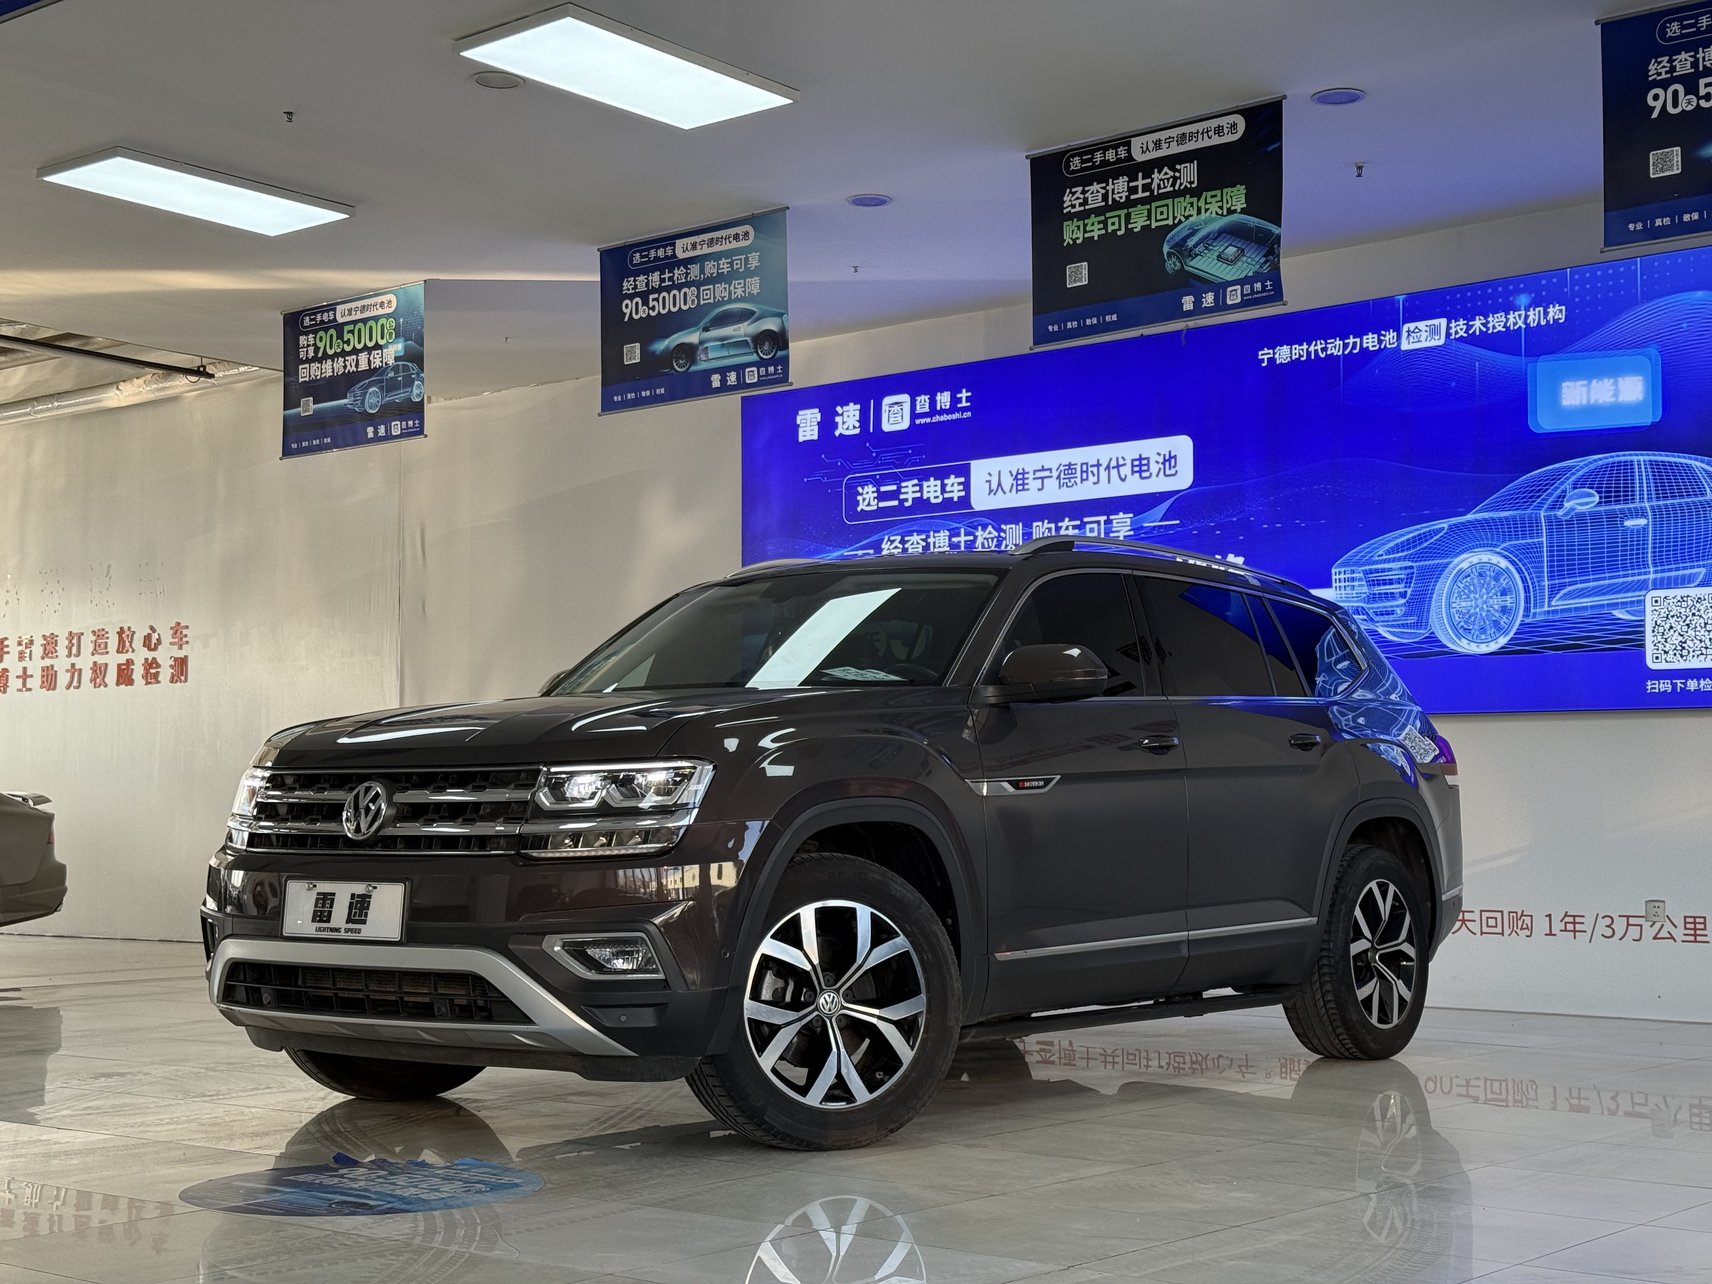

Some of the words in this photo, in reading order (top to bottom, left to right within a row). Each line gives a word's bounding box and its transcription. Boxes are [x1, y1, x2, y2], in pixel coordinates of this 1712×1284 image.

[1666, 14, 1712, 38] 选二手
[1070, 146, 1128, 171] 选二手电车
[1140, 120, 1238, 155] 认准宁德时代电池
[1063, 160, 1198, 214] 经查博士检测
[1063, 184, 1246, 246] 购车可享回购保障
[632, 246, 674, 264] 选二手电车
[682, 230, 750, 254] 认准宁德时代电池
[700, 277, 760, 306] 回购保障
[1258, 328, 1398, 367] 宁德时代动力电池
[1405, 321, 1442, 346] 检测
[1449, 304, 1566, 340] 技术授权机构
[299, 348, 396, 383] 回购维修双重保障
[796, 402, 861, 442] 雷速
[915, 388, 972, 414] 查博士
[915, 410, 972, 424] www.chaboshi.cn
[856, 474, 966, 512] 选二手电车
[986, 450, 1178, 497] 认准宁德时代电池
[1646, 678, 1712, 693] 扫码下单检
[311, 892, 372, 925] 雷速
[315, 926, 342, 934] LIGHTNING
[1452, 909, 1534, 938] 天回购
[1544, 911, 1710, 944] 1年/3万公里
